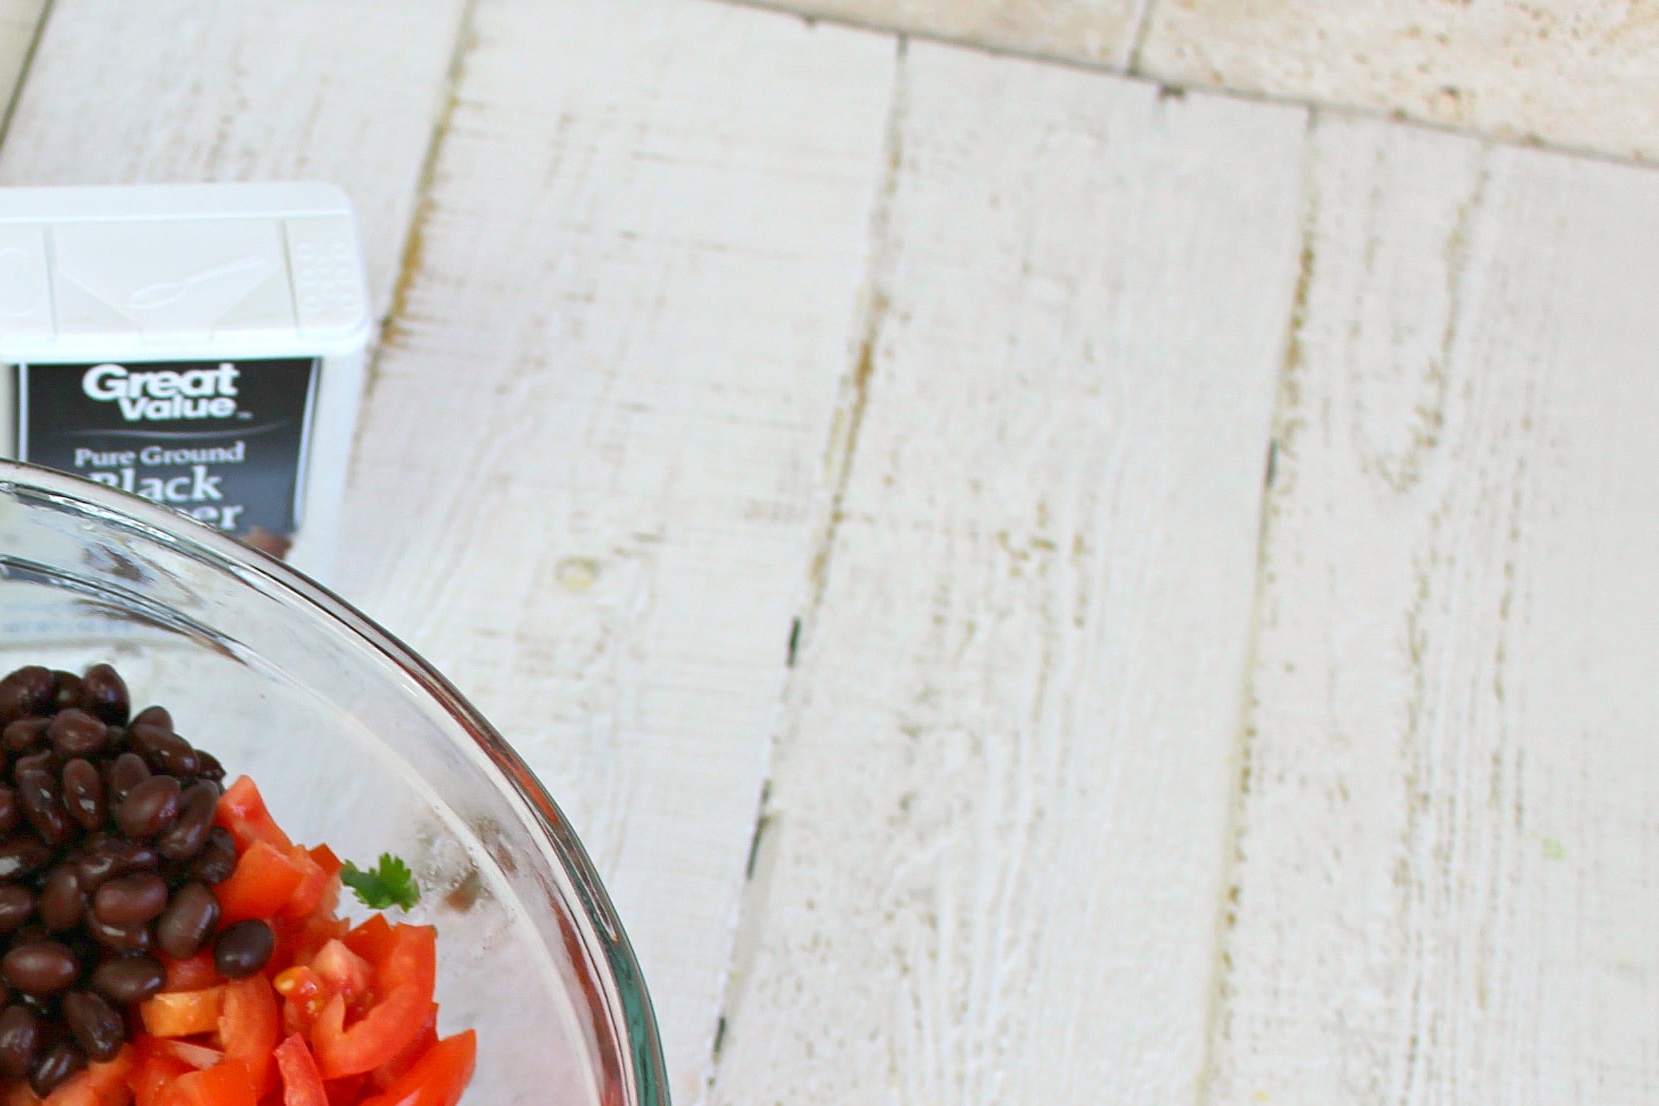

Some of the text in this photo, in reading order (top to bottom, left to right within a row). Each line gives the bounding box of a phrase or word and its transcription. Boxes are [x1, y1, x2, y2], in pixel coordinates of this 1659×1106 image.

[82, 362, 240, 402] Great
[118, 394, 237, 422] Value
[74, 440, 246, 468] Pure Ground
